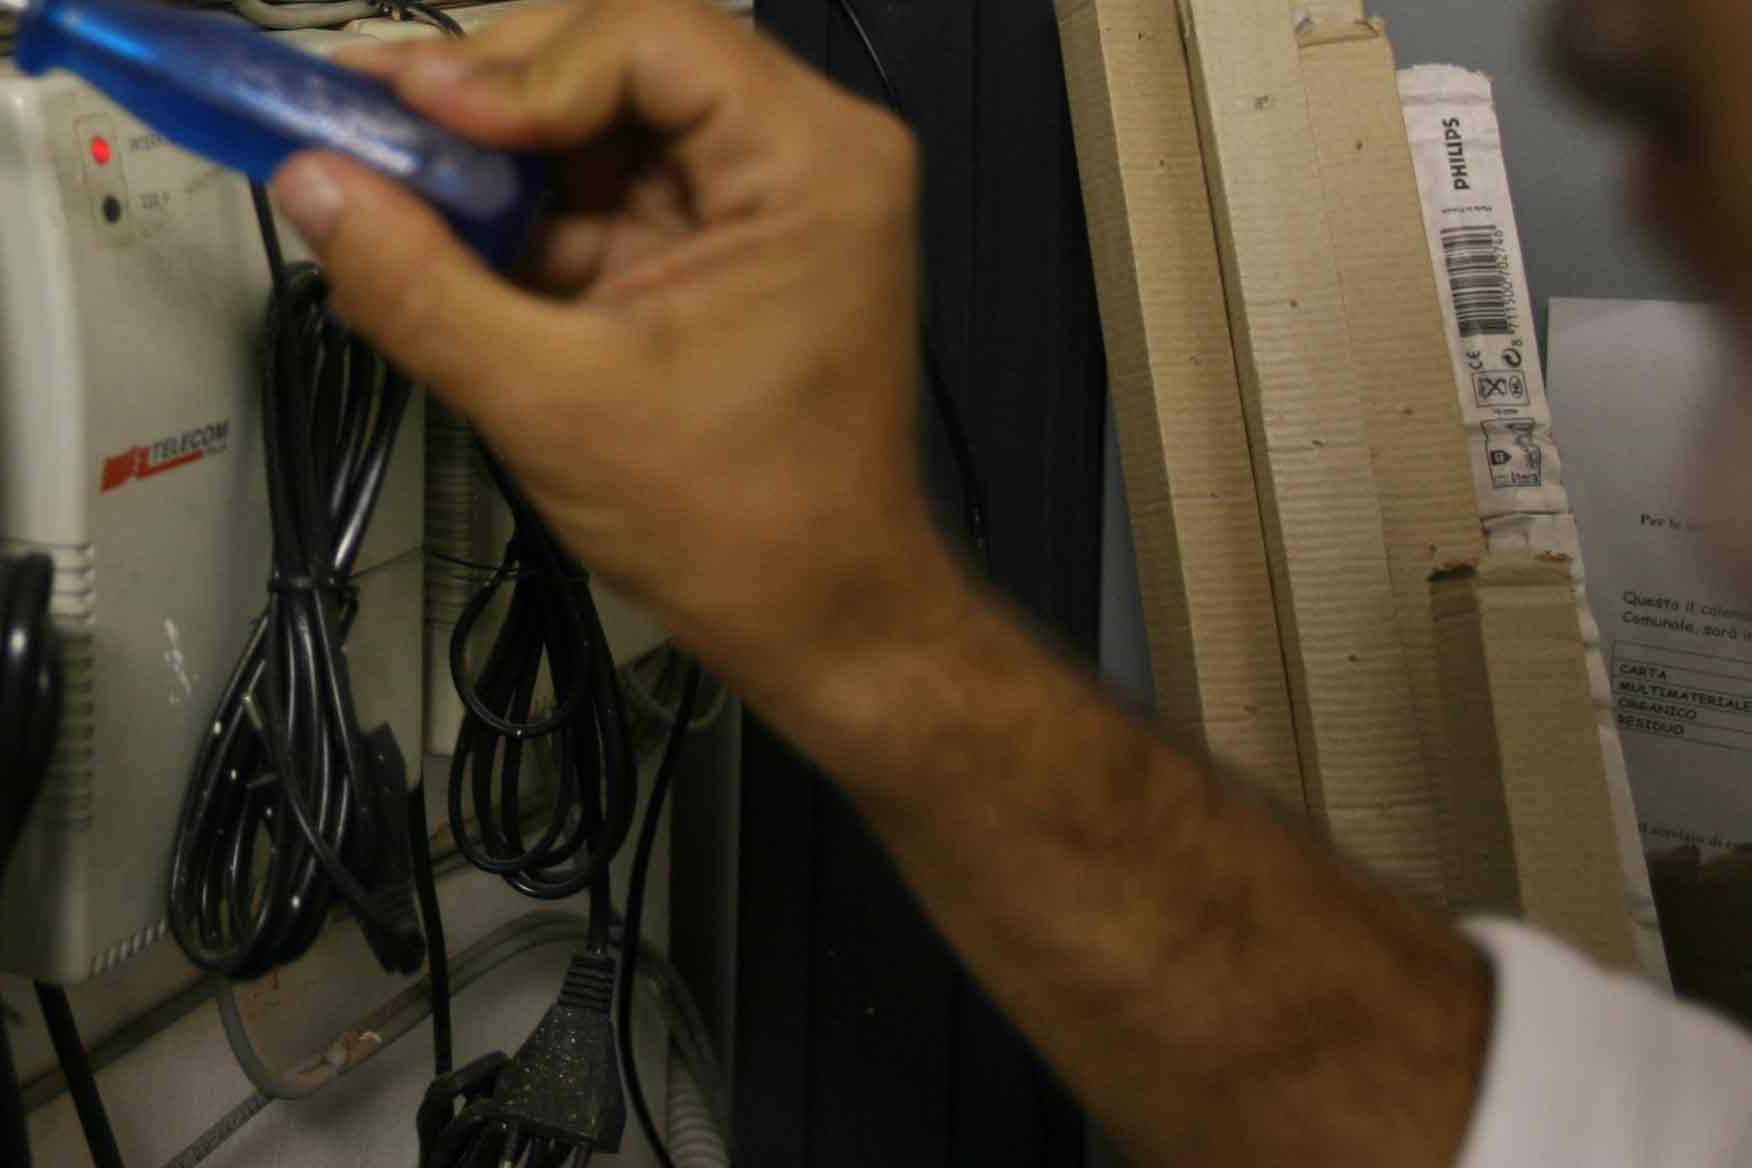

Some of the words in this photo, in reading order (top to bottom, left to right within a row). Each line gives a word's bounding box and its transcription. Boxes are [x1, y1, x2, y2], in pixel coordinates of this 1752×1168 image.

[1441, 117, 1470, 190] PHILIPS
[152, 417, 230, 464] TELECOM
[1623, 591, 1680, 612] Questo
[1619, 663, 1667, 681] CARTA
